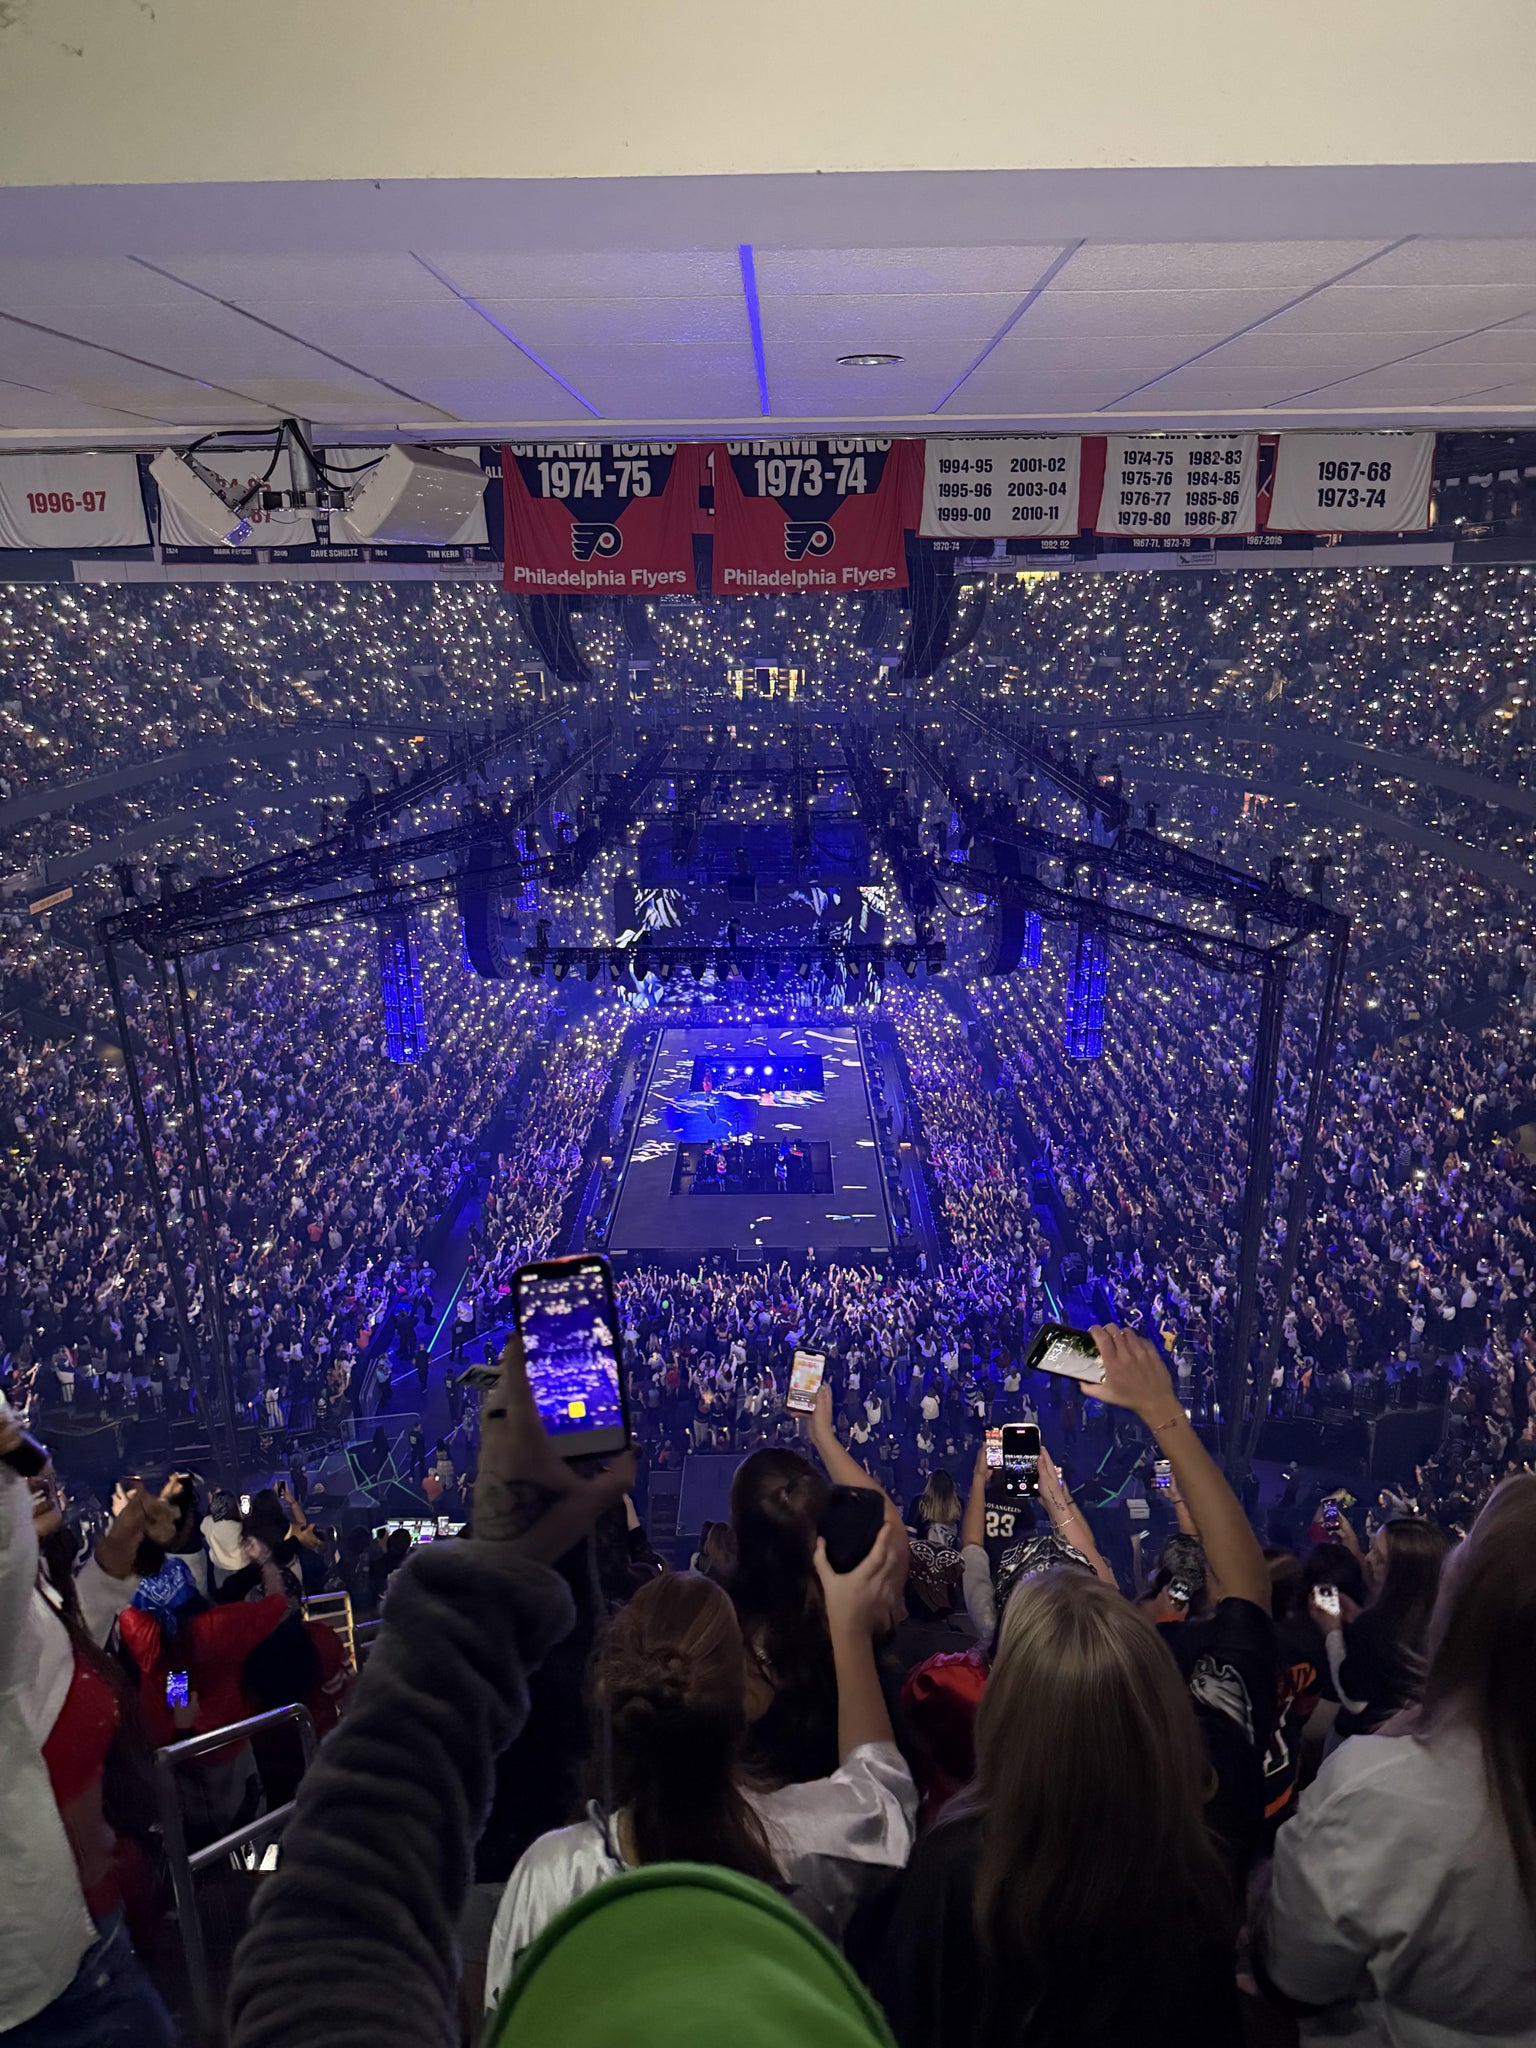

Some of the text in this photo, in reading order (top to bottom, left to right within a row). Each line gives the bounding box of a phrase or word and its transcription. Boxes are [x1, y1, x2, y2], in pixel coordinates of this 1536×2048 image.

[939, 457, 1066, 473] 1994-95 2001-02
[1123, 450, 1242, 465] 1974-75 1982-83
[754, 457, 868, 497] 1973-74
[1121, 470, 1241, 486] 1975-76 1984-85
[1318, 461, 1392, 481] 1967-68
[537, 461, 652, 498] 1974-75
[938, 482, 1067, 497] 1995-96 2003-04
[26, 491, 106, 514] 1996-97
[1120, 491, 1240, 506] 1976-77 1985-86
[1318, 488, 1386, 508] 1973-74
[938, 506, 1059, 522] 1999-00 2010-11
[1118, 511, 1237, 526] 1979-80 1986-87
[310, 548, 359, 558] DAVE SCHULTZ
[426, 550, 440, 558] TIM
[514, 566, 687, 589] Philadelphia Flyers
[724, 566, 896, 588] Philadelphia Flyers
[985, 1511, 1016, 1538] 23
